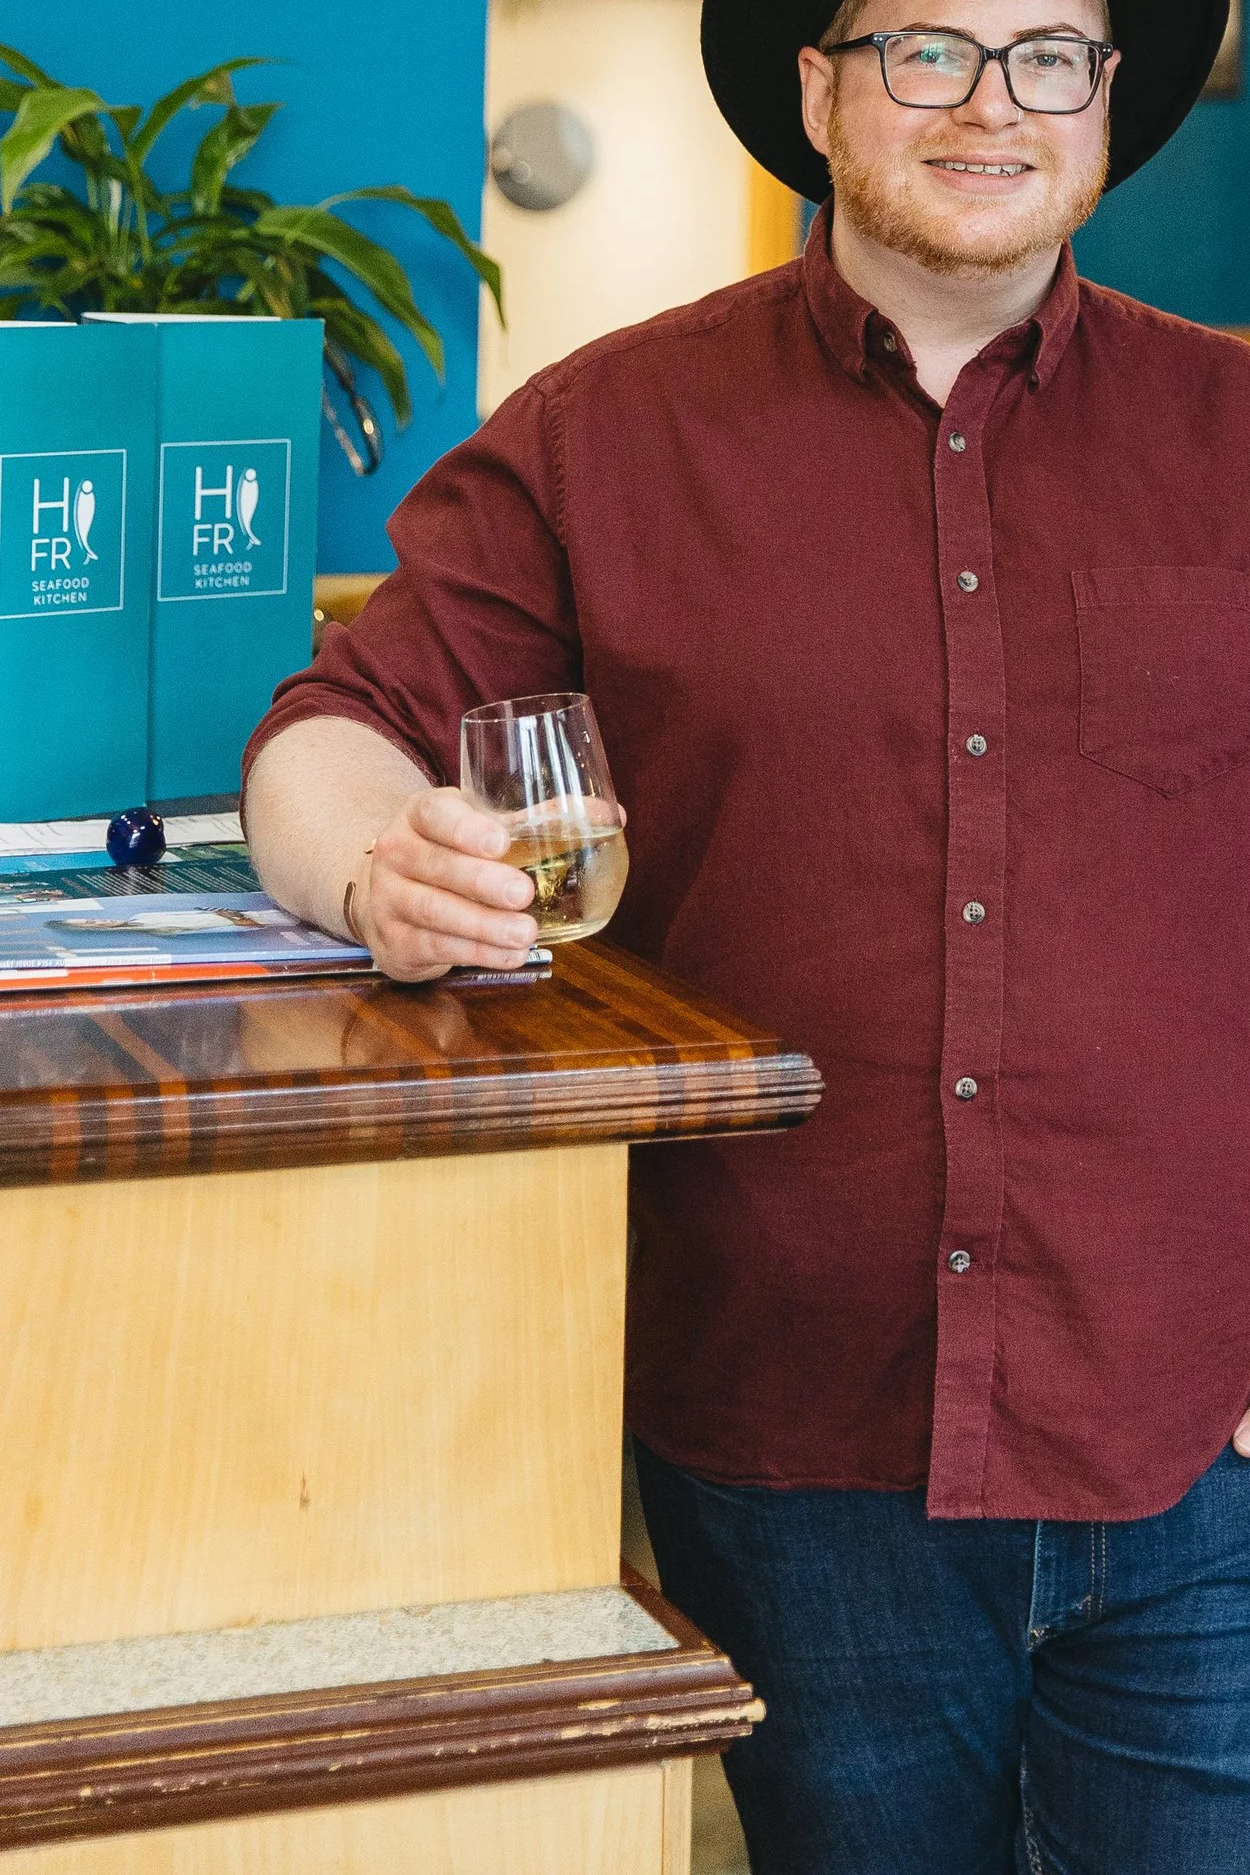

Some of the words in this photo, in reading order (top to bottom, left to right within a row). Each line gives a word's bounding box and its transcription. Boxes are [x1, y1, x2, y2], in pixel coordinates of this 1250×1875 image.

[193, 561, 253, 576] SEAFOOD
[31, 577, 90, 592] SEAFOOD
[195, 574, 250, 589] KITCHEN
[33, 591, 87, 606] KITCHEN
